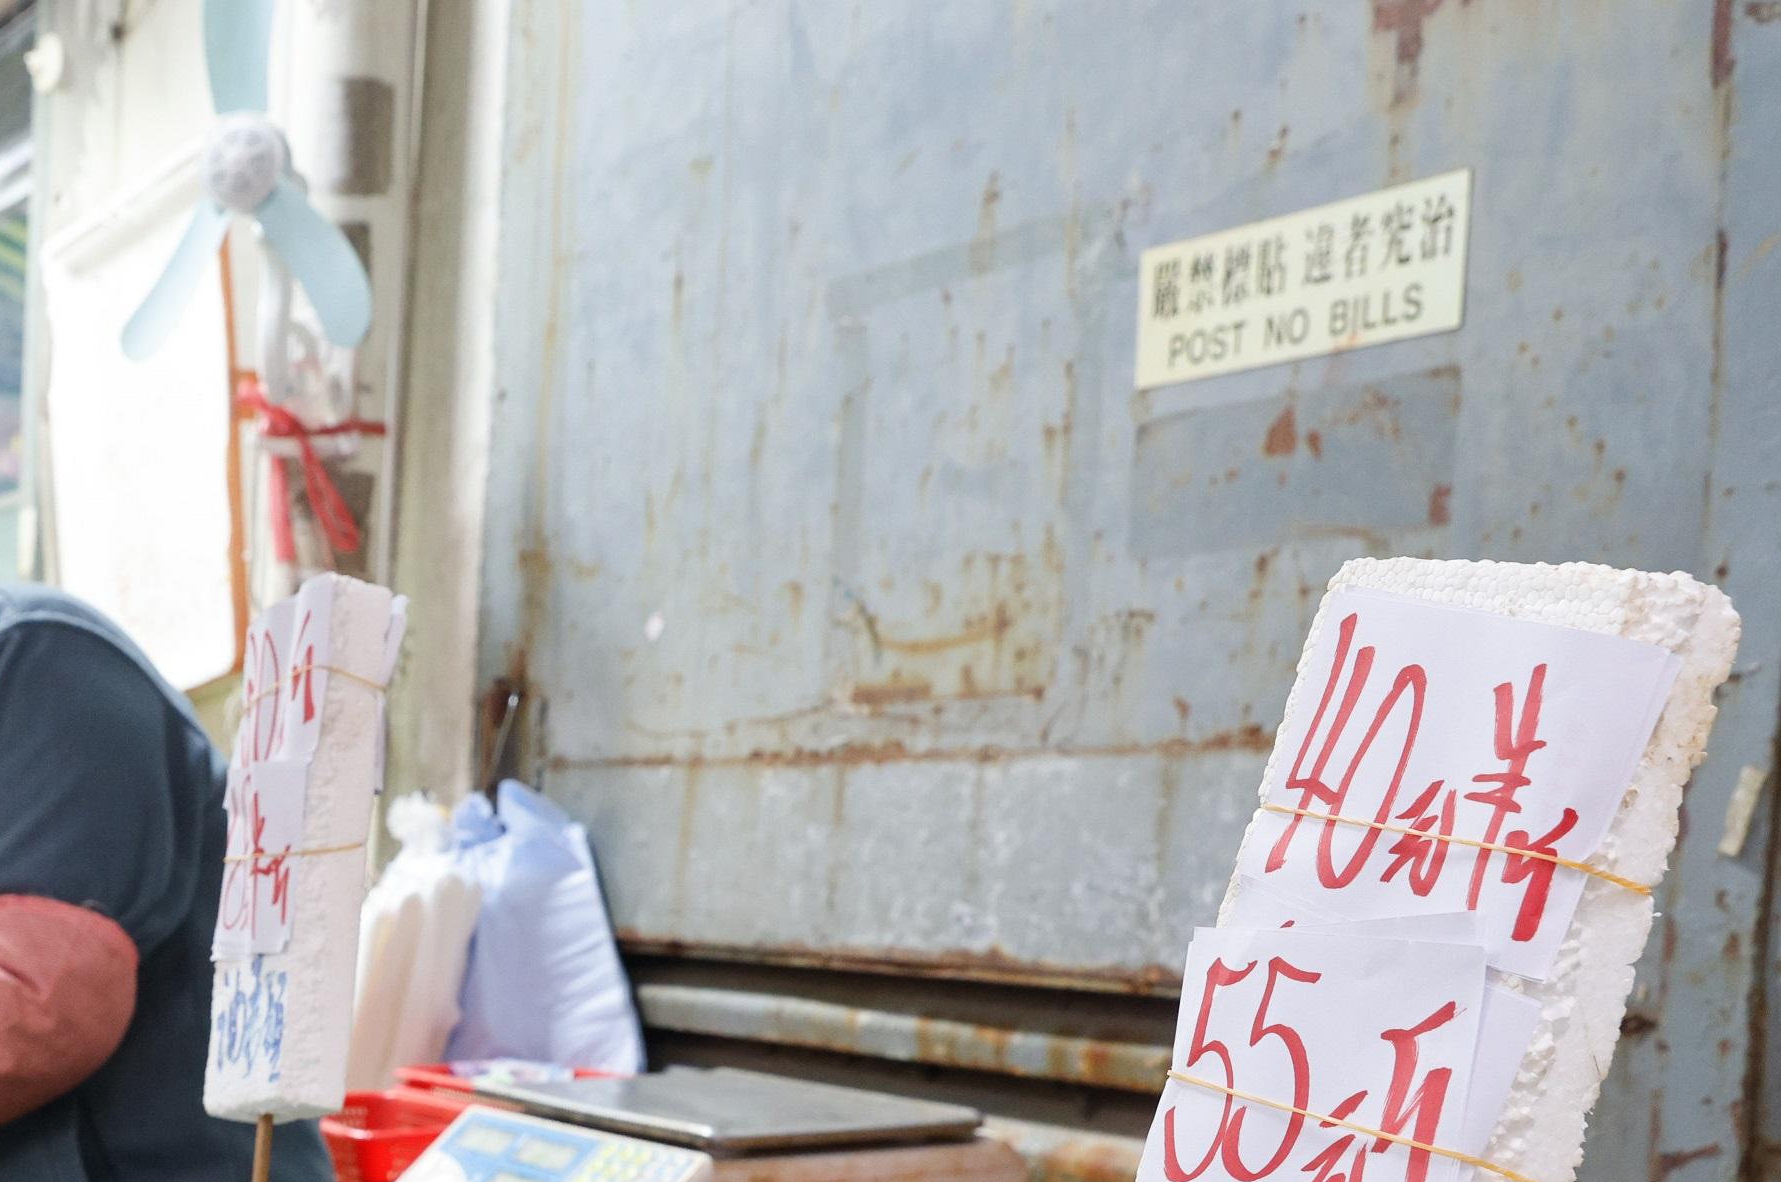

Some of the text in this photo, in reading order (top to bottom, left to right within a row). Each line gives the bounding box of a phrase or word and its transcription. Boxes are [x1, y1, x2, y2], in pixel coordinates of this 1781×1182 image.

[1167, 283, 1424, 369] POST NO BILLS
